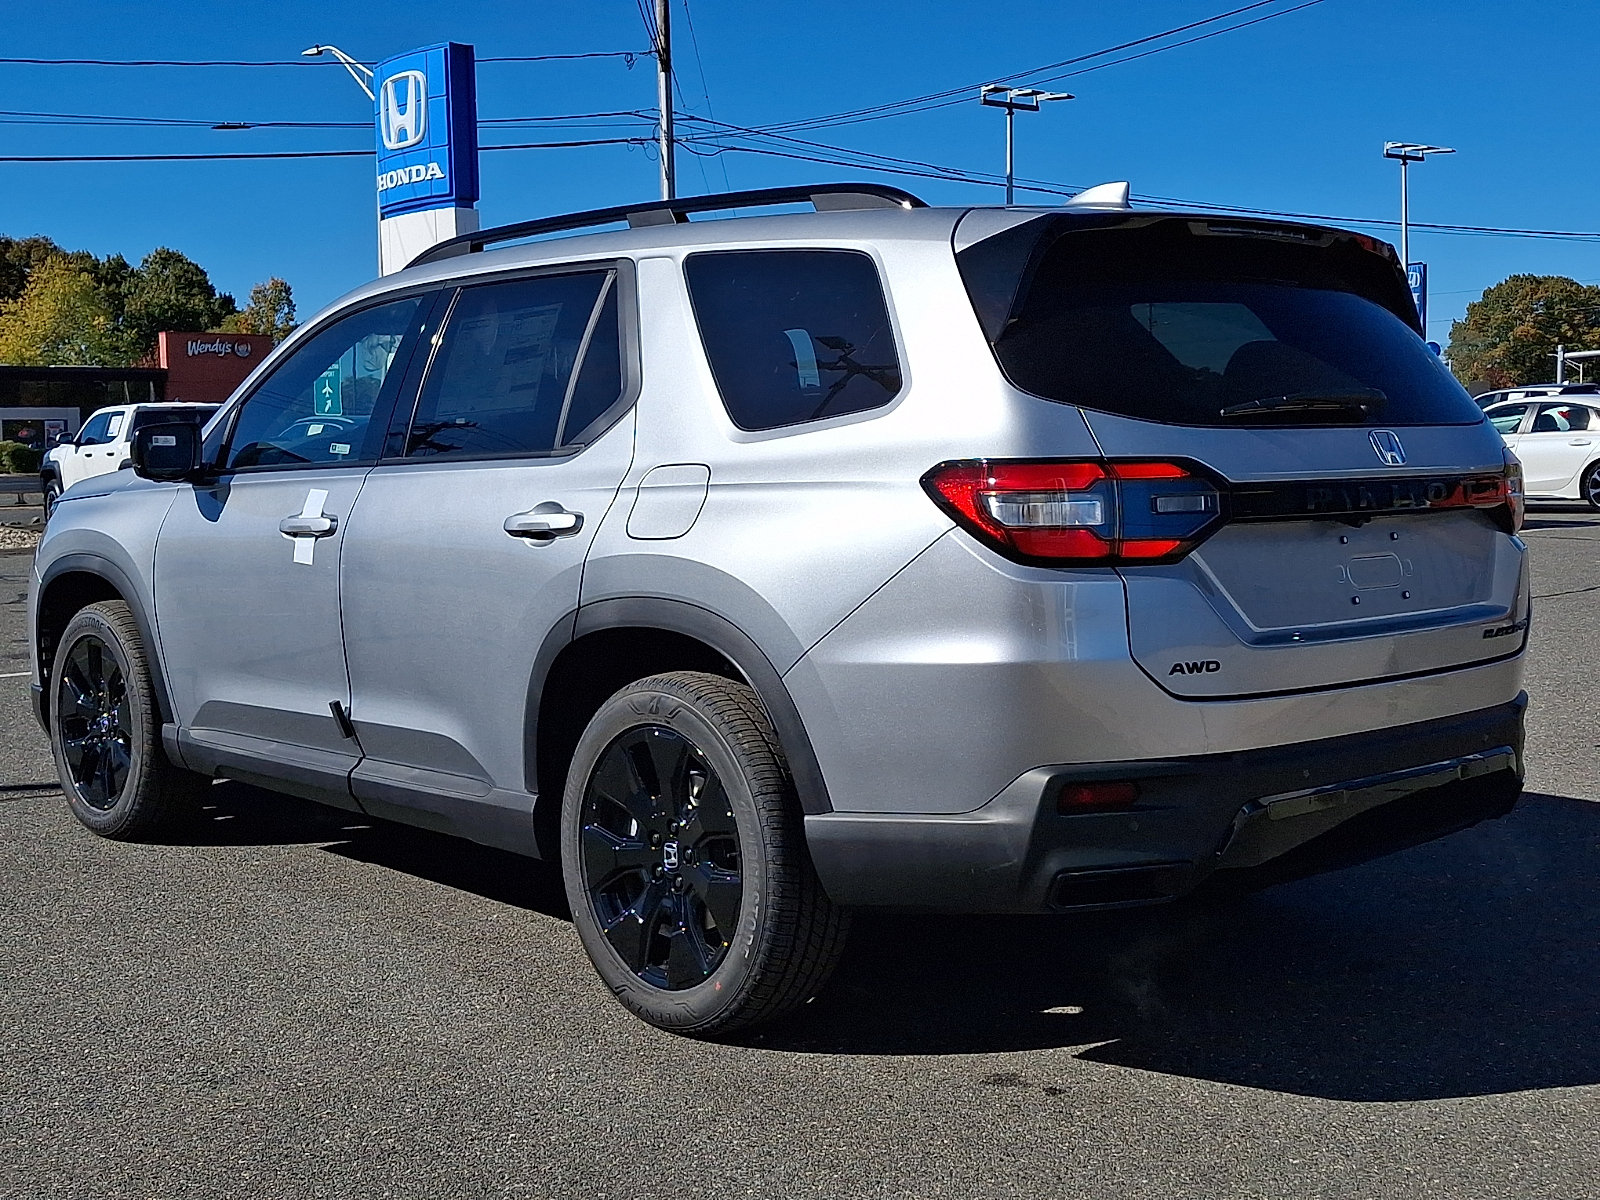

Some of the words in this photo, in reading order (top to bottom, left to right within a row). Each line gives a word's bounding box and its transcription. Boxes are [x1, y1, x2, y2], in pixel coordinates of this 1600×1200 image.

[377, 162, 445, 192] HONDA
[187, 338, 232, 357] Wendy's
[1168, 660, 1221, 676] AWD
